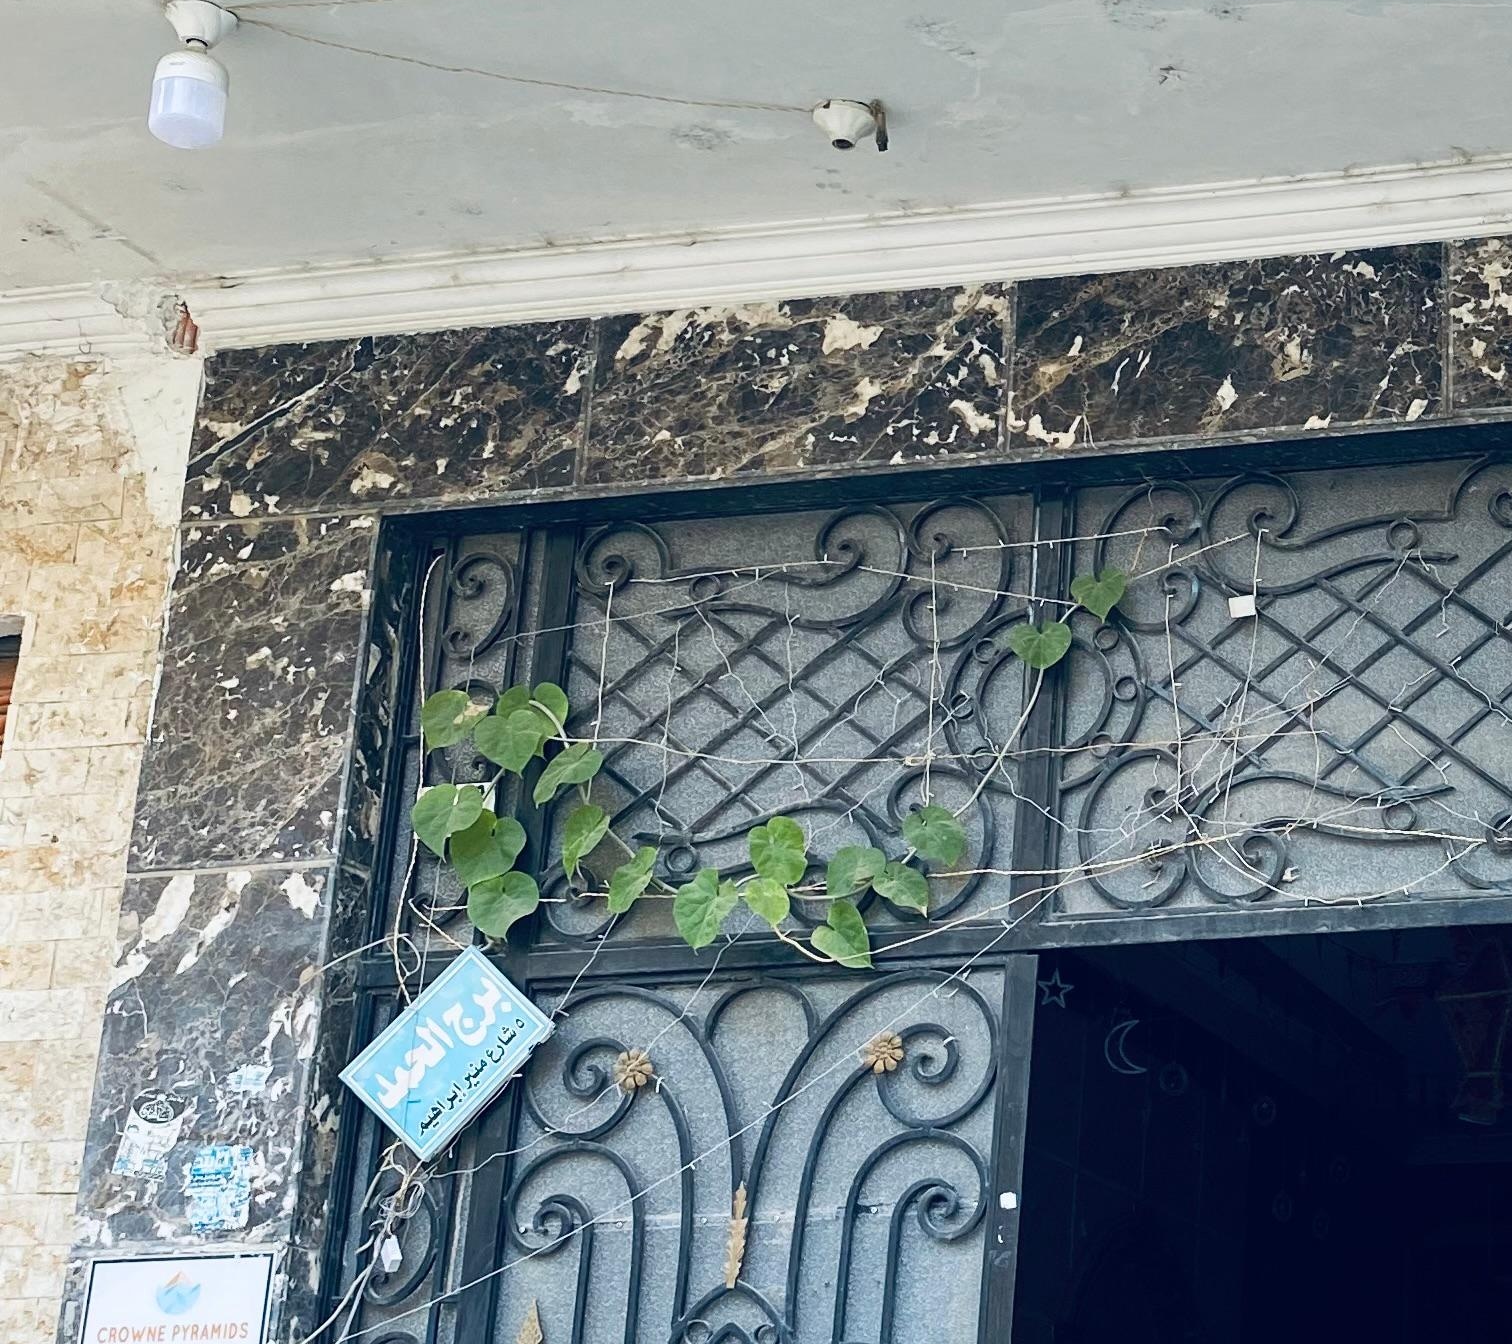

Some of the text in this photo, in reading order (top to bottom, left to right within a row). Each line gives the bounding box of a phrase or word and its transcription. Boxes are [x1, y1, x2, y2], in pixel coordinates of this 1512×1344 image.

[441, 976, 513, 1047] برج
[486, 1026, 518, 1064] شارع
[464, 1059, 488, 1089] منير
[97, 1322, 249, 1344] CROWNE PYRAMIDS
